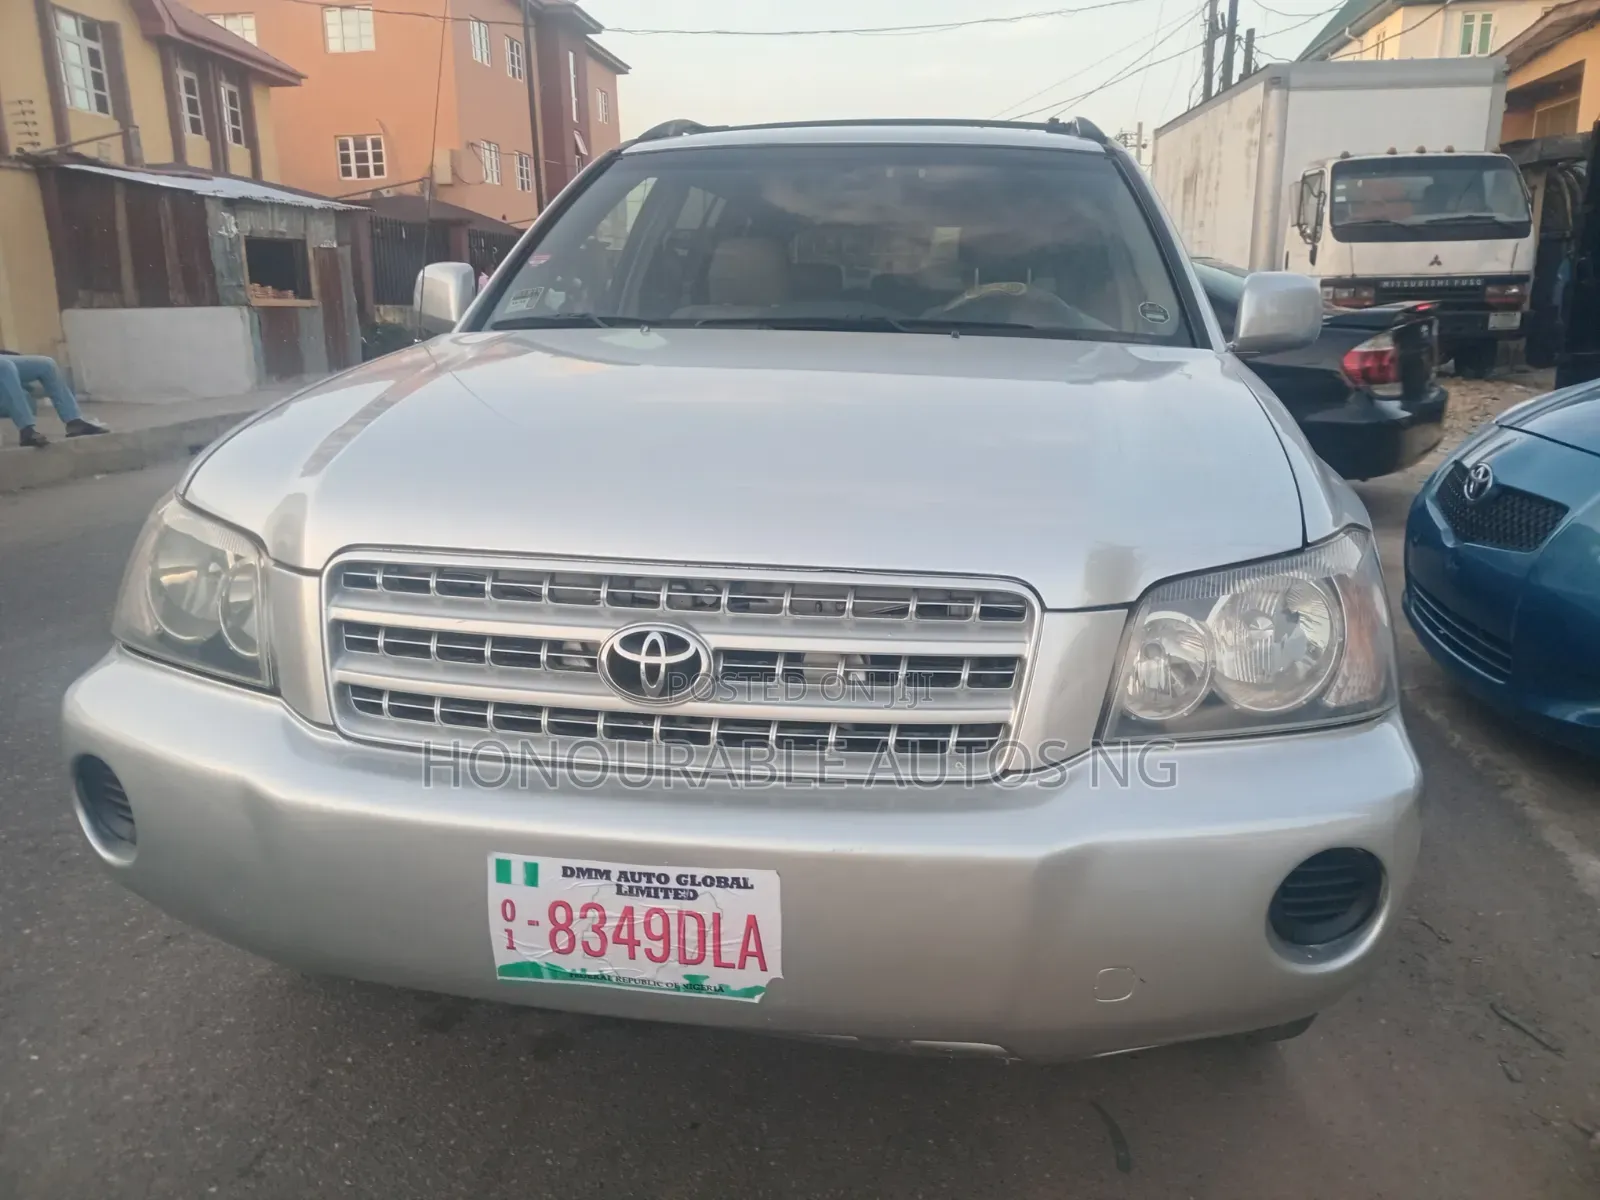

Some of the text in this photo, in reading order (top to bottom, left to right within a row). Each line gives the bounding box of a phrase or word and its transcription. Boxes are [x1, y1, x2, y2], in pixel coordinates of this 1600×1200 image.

[1382, 279, 1483, 288] MITSUBISHI FUSO
[561, 865, 755, 890] DMM AUTO GLOBAL
[615, 883, 699, 900] LIMITED
[615, 975, 663, 988] REPUBLIC
[665, 981, 678, 989] OF
[682, 983, 725, 993] NIGERIA
